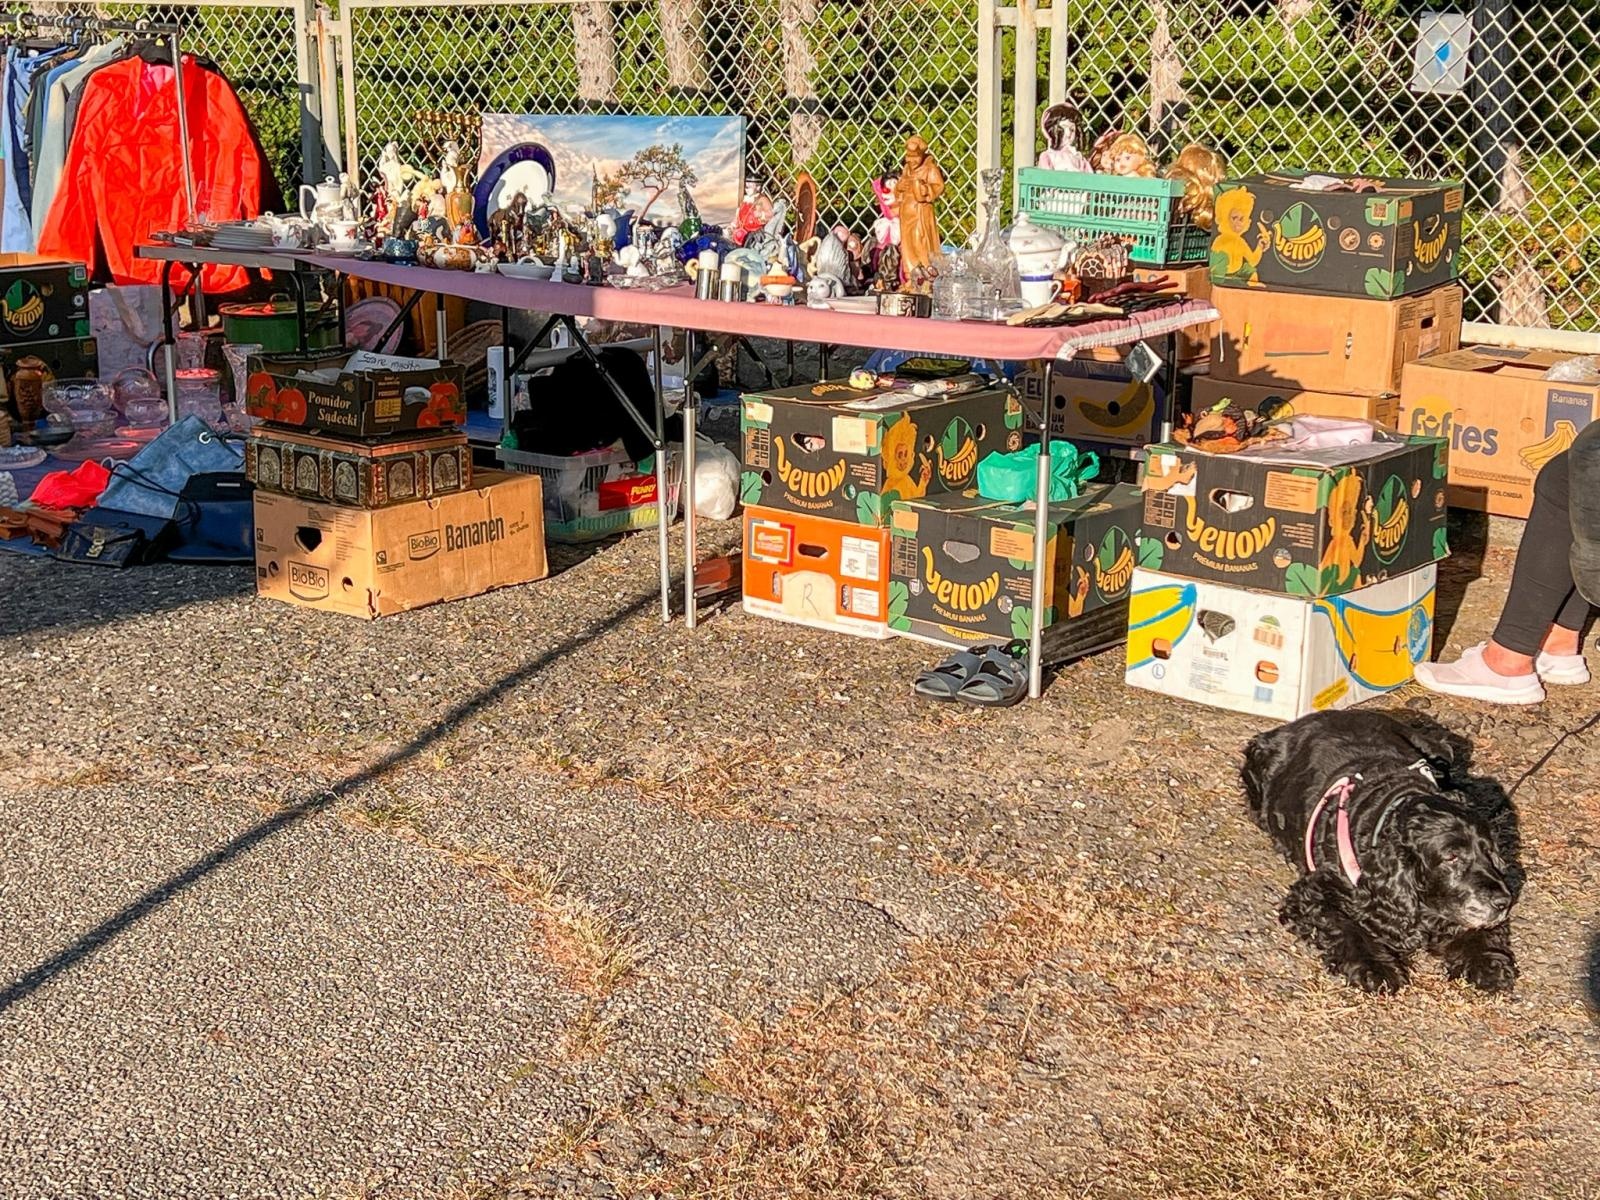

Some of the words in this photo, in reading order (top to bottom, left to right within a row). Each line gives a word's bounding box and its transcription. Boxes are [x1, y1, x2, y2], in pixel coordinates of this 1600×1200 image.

[308, 390, 351, 410] Pomidor
[1551, 392, 1589, 407] Bananas
[317, 407, 358, 427] Sądecki
[783, 491, 808, 509] PREMIUM
[807, 499, 834, 511] BANANAS
[1489, 489, 1523, 500] COLOMBIA
[410, 534, 439, 551] BioBio
[445, 516, 506, 553] Bananen
[1192, 551, 1225, 572] PREMIUM
[1224, 561, 1260, 574] BANANAS
[291, 566, 326, 589] BioBio
[801, 582, 821, 618] R
[931, 603, 959, 621] PREMIUM
[958, 613, 988, 623] BANANAS
